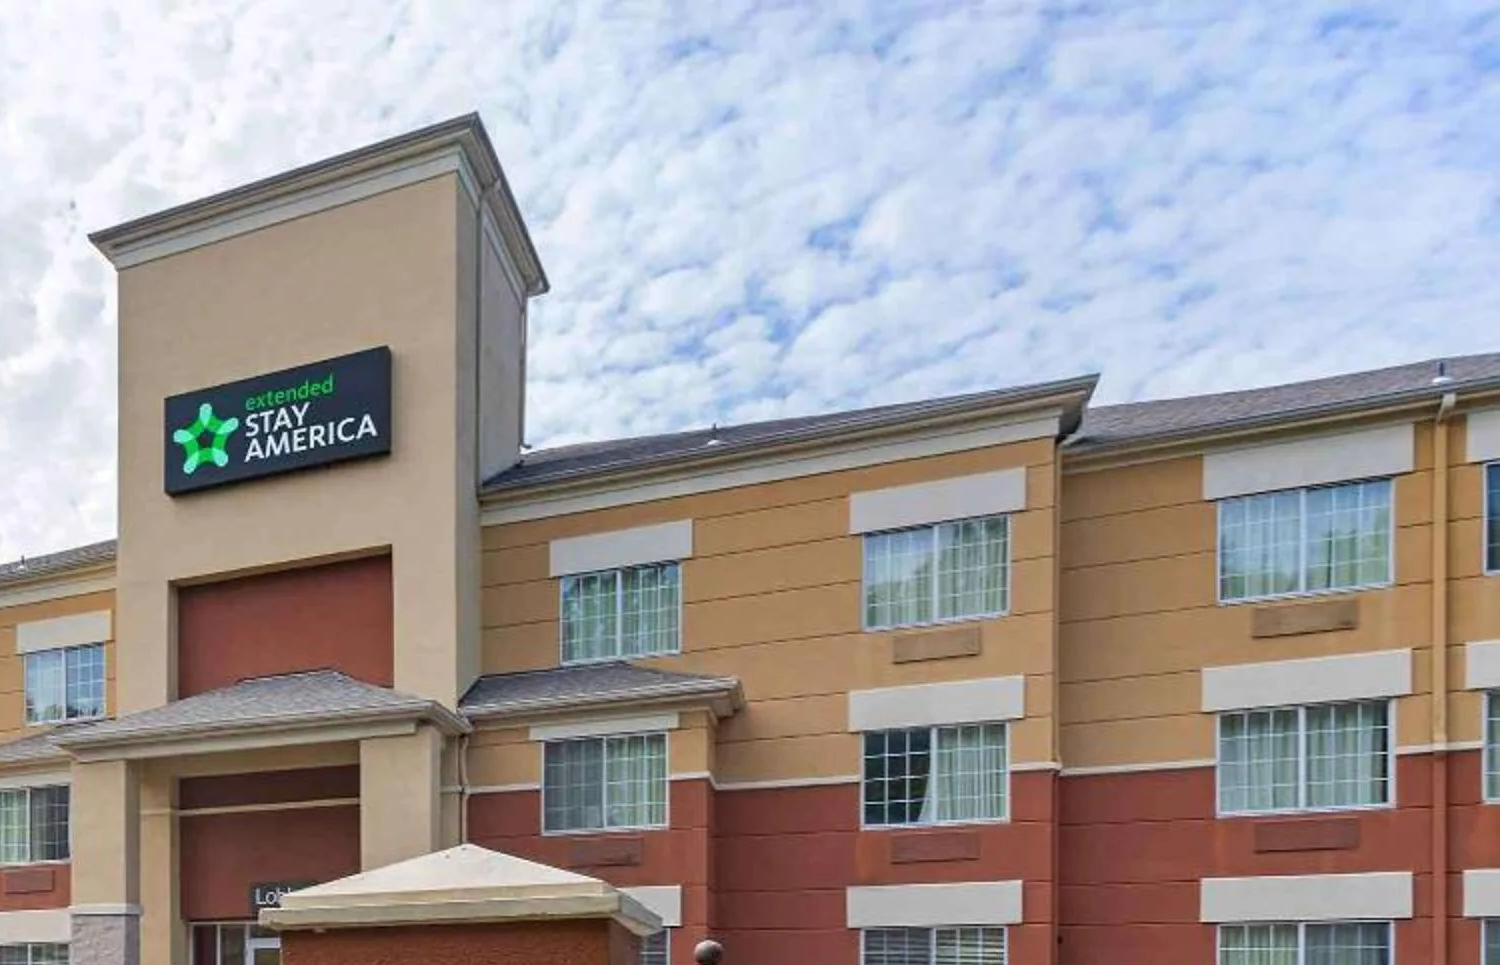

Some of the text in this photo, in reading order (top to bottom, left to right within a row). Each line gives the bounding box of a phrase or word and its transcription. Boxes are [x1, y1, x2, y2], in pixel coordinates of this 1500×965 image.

[245, 373, 335, 410] extended
[245, 402, 311, 437] STAY
[244, 414, 378, 463] AMERICA
